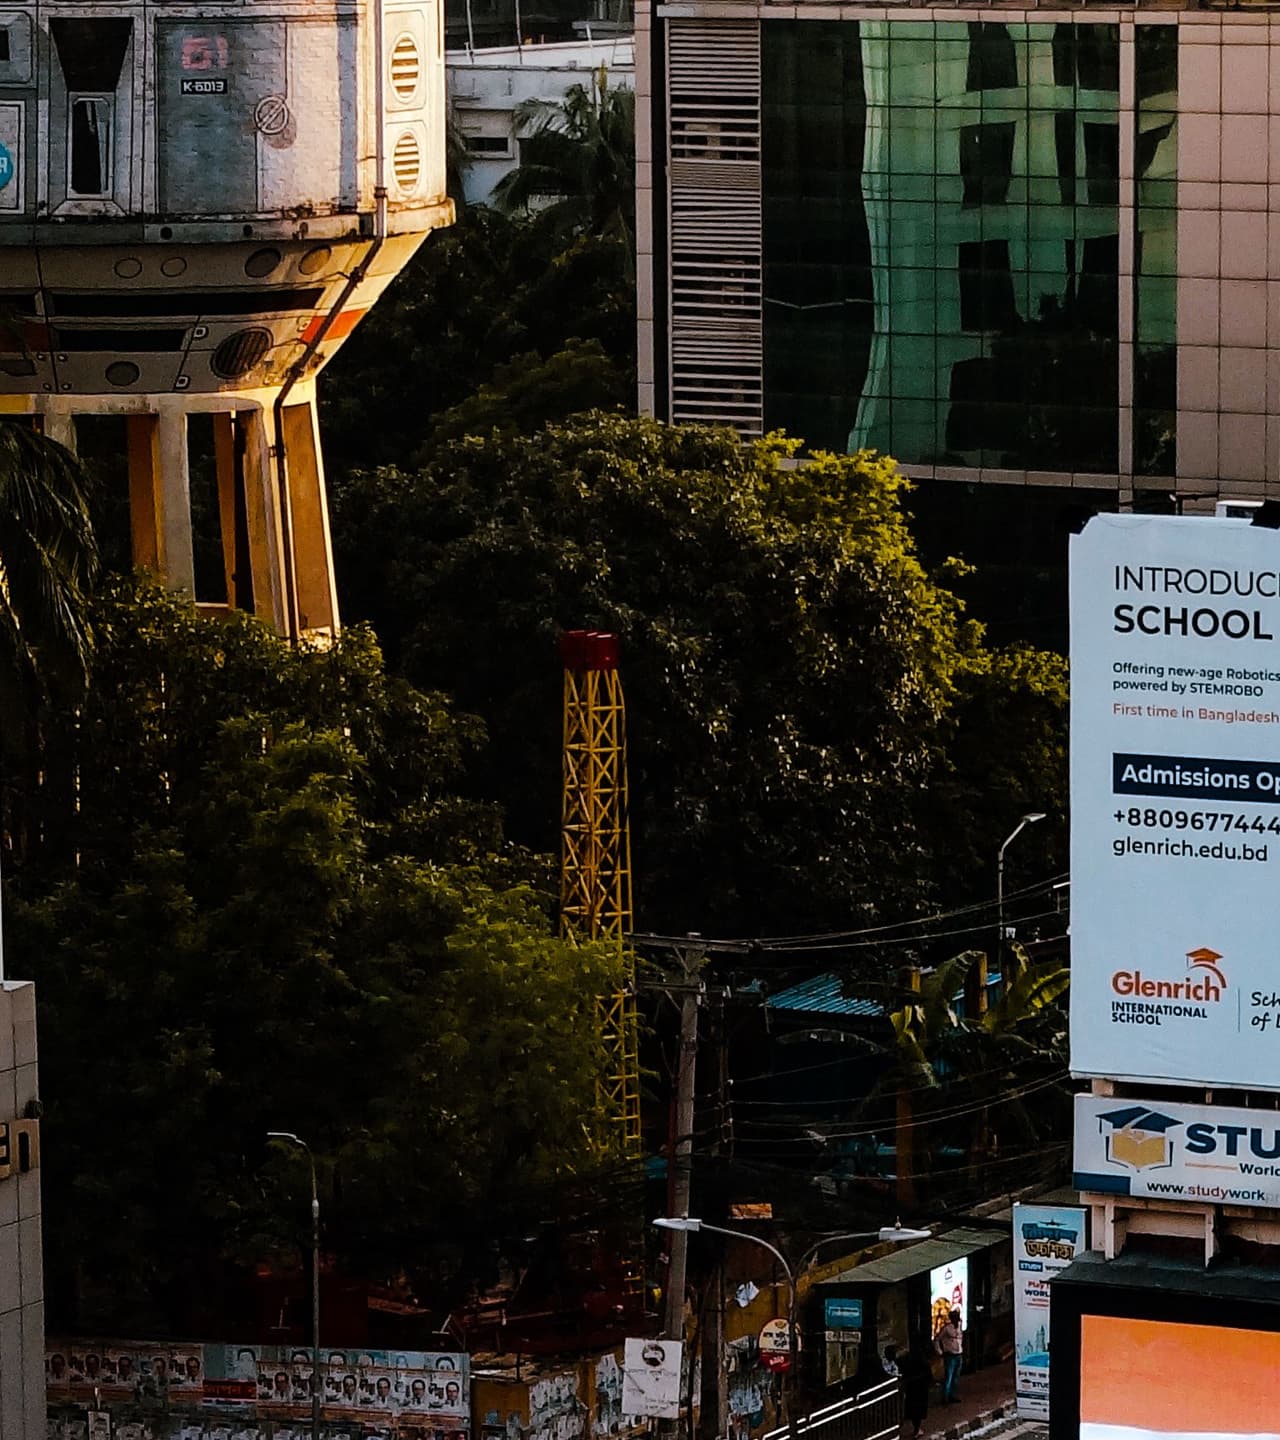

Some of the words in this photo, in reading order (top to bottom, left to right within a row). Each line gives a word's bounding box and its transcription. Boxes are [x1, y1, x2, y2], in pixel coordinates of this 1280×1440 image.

[1113, 604, 1273, 640] SCHOOL
[1112, 662, 1165, 679] Offering
[1167, 666, 1223, 682] new-age
[1112, 679, 1168, 694] powered
[1171, 680, 1187, 696] by
[1190, 682, 1264, 698] STEMROBO
[1113, 703, 1143, 717] First
[1146, 704, 1178, 718] time
[1182, 705, 1195, 719] in
[1198, 707, 1280, 724] Bangladesh
[1121, 763, 1251, 790] Admissions
[1112, 836, 1269, 862] glenrich.edu.bd
[1111, 970, 1221, 1003] Glenrich
[1111, 1001, 1208, 1019] INTERNATIONAL
[1111, 1012, 1162, 1026] SCHOOL
[1251, 1012, 1272, 1032] of
[1024, 1289, 1049, 1298] WORL
